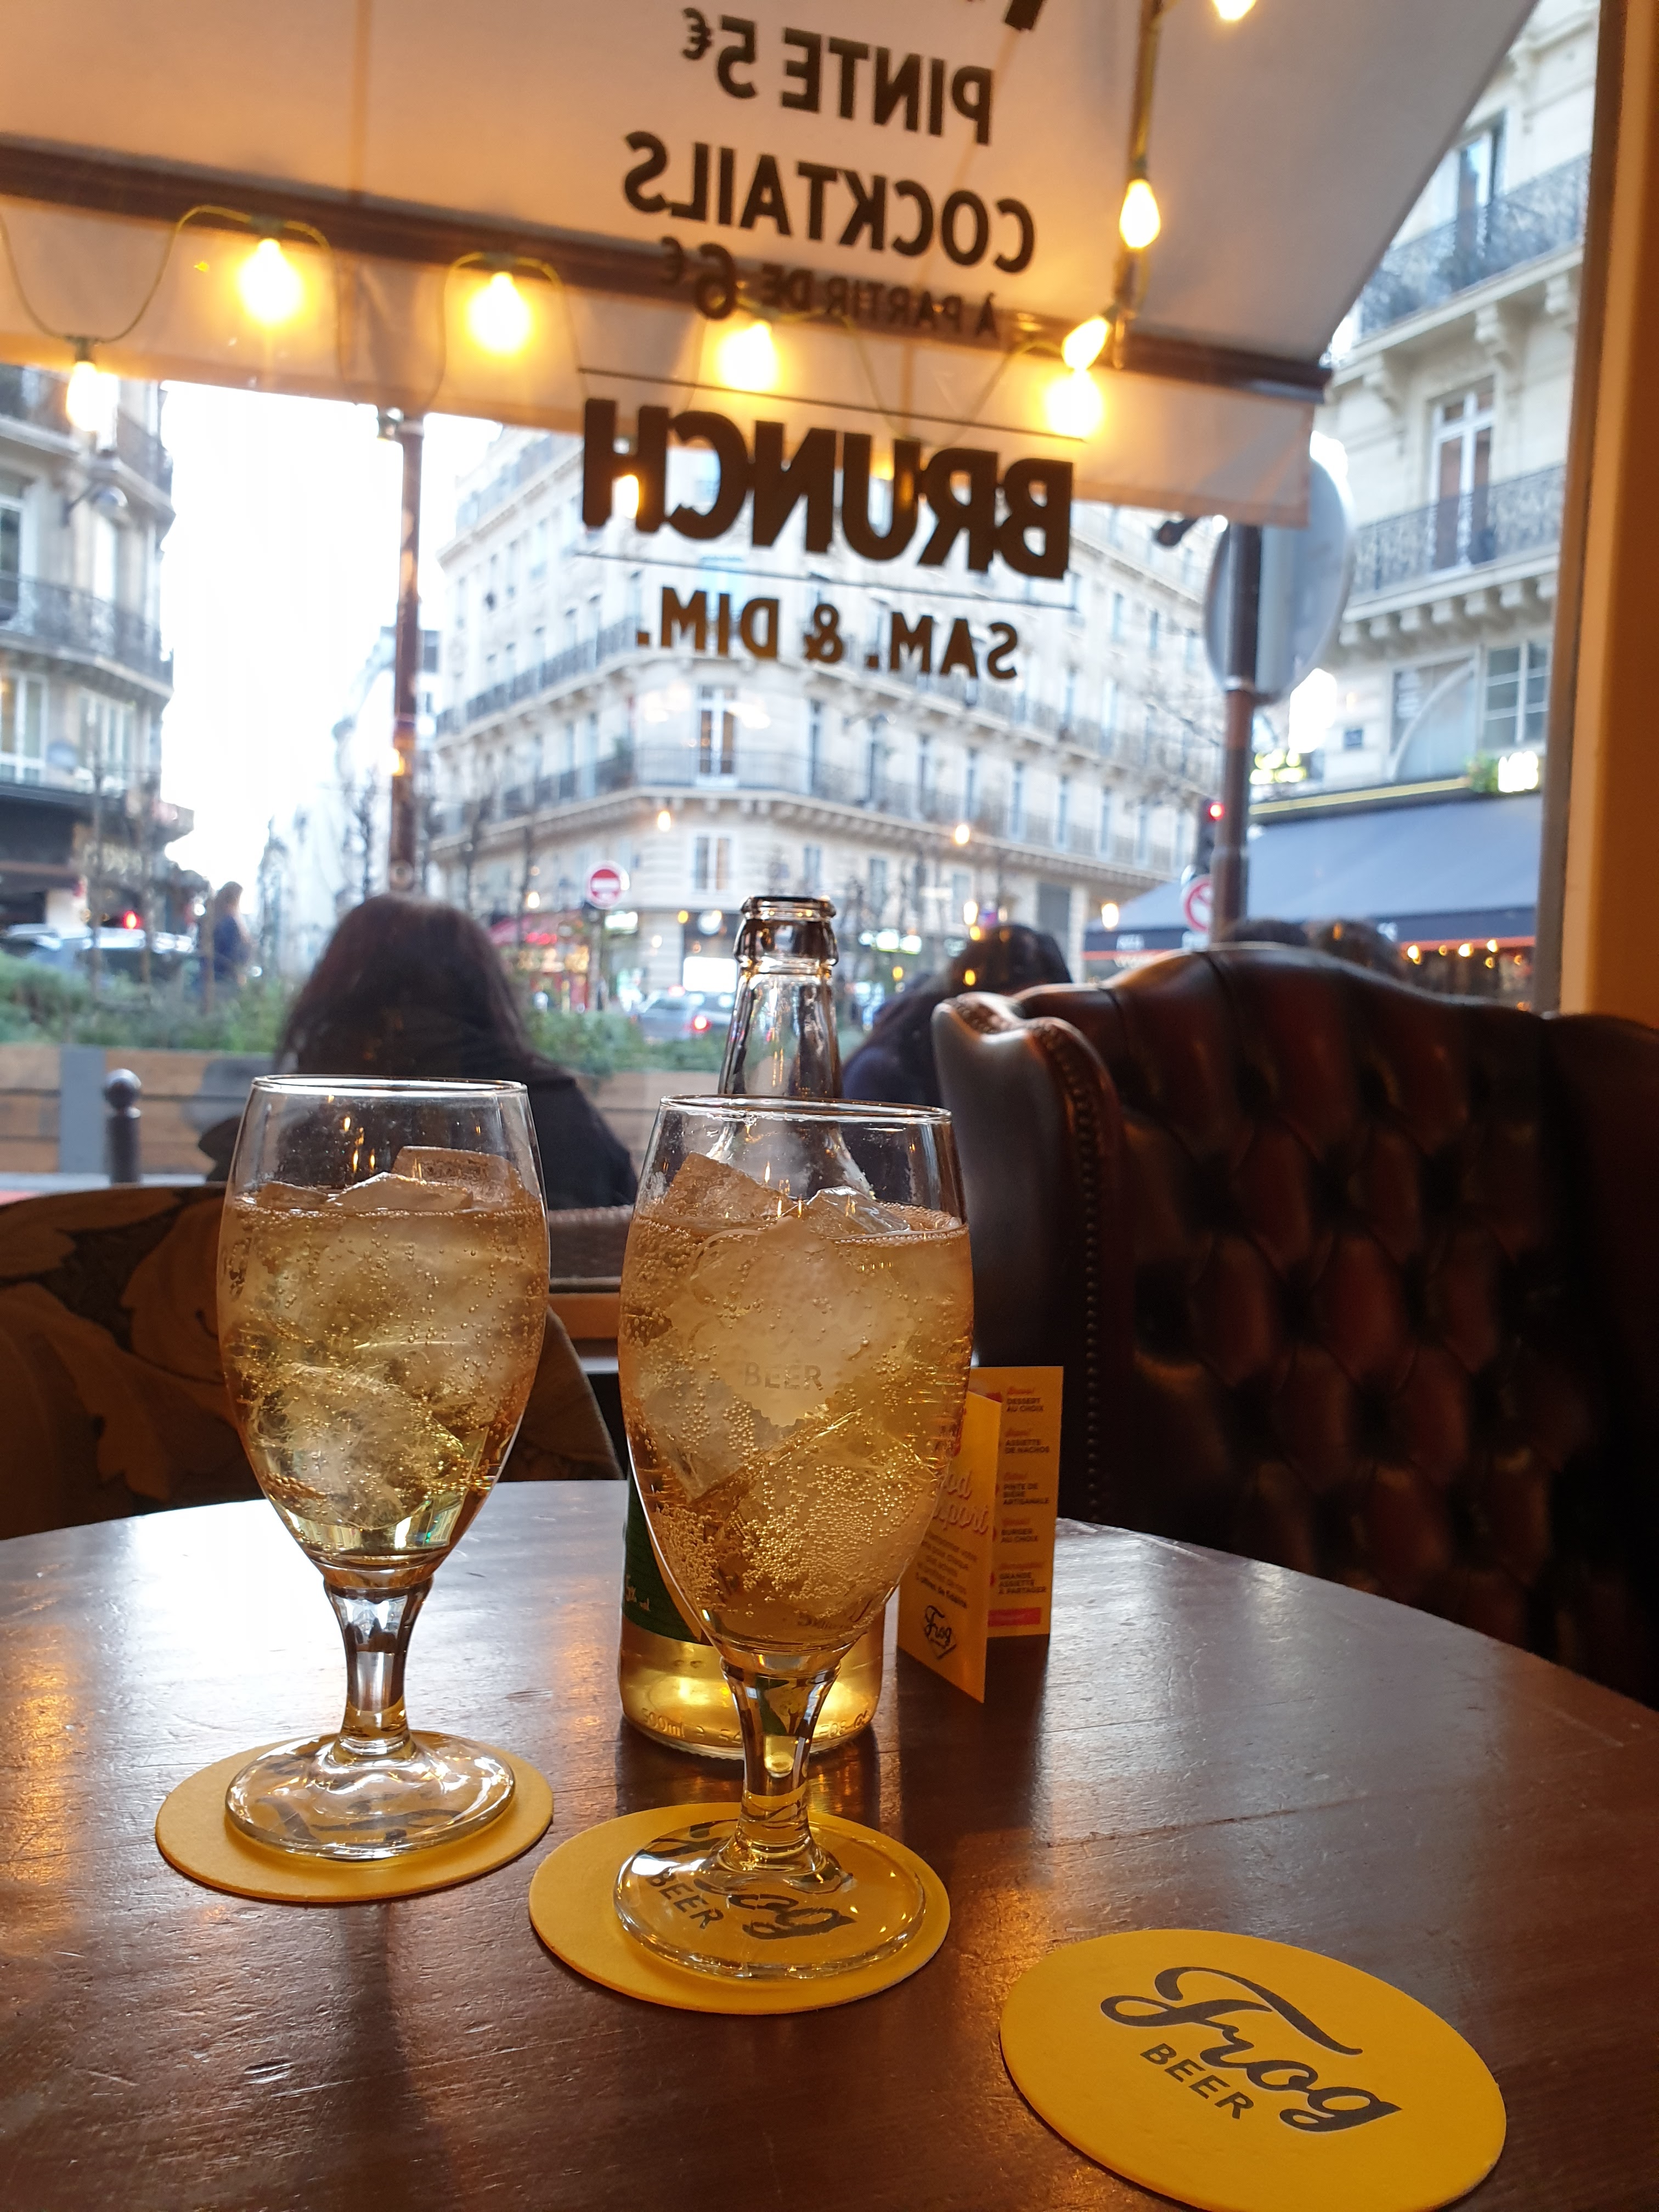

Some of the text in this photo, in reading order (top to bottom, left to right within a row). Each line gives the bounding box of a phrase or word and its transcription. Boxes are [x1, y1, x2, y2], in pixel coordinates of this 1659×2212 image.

[744, 1362, 823, 1391] BEER
[923, 1604, 952, 1648] Frog
[645, 1866, 725, 1931] BEER
[1099, 1966, 1402, 2133] Frog
[1139, 2042, 1255, 2120] BEER
